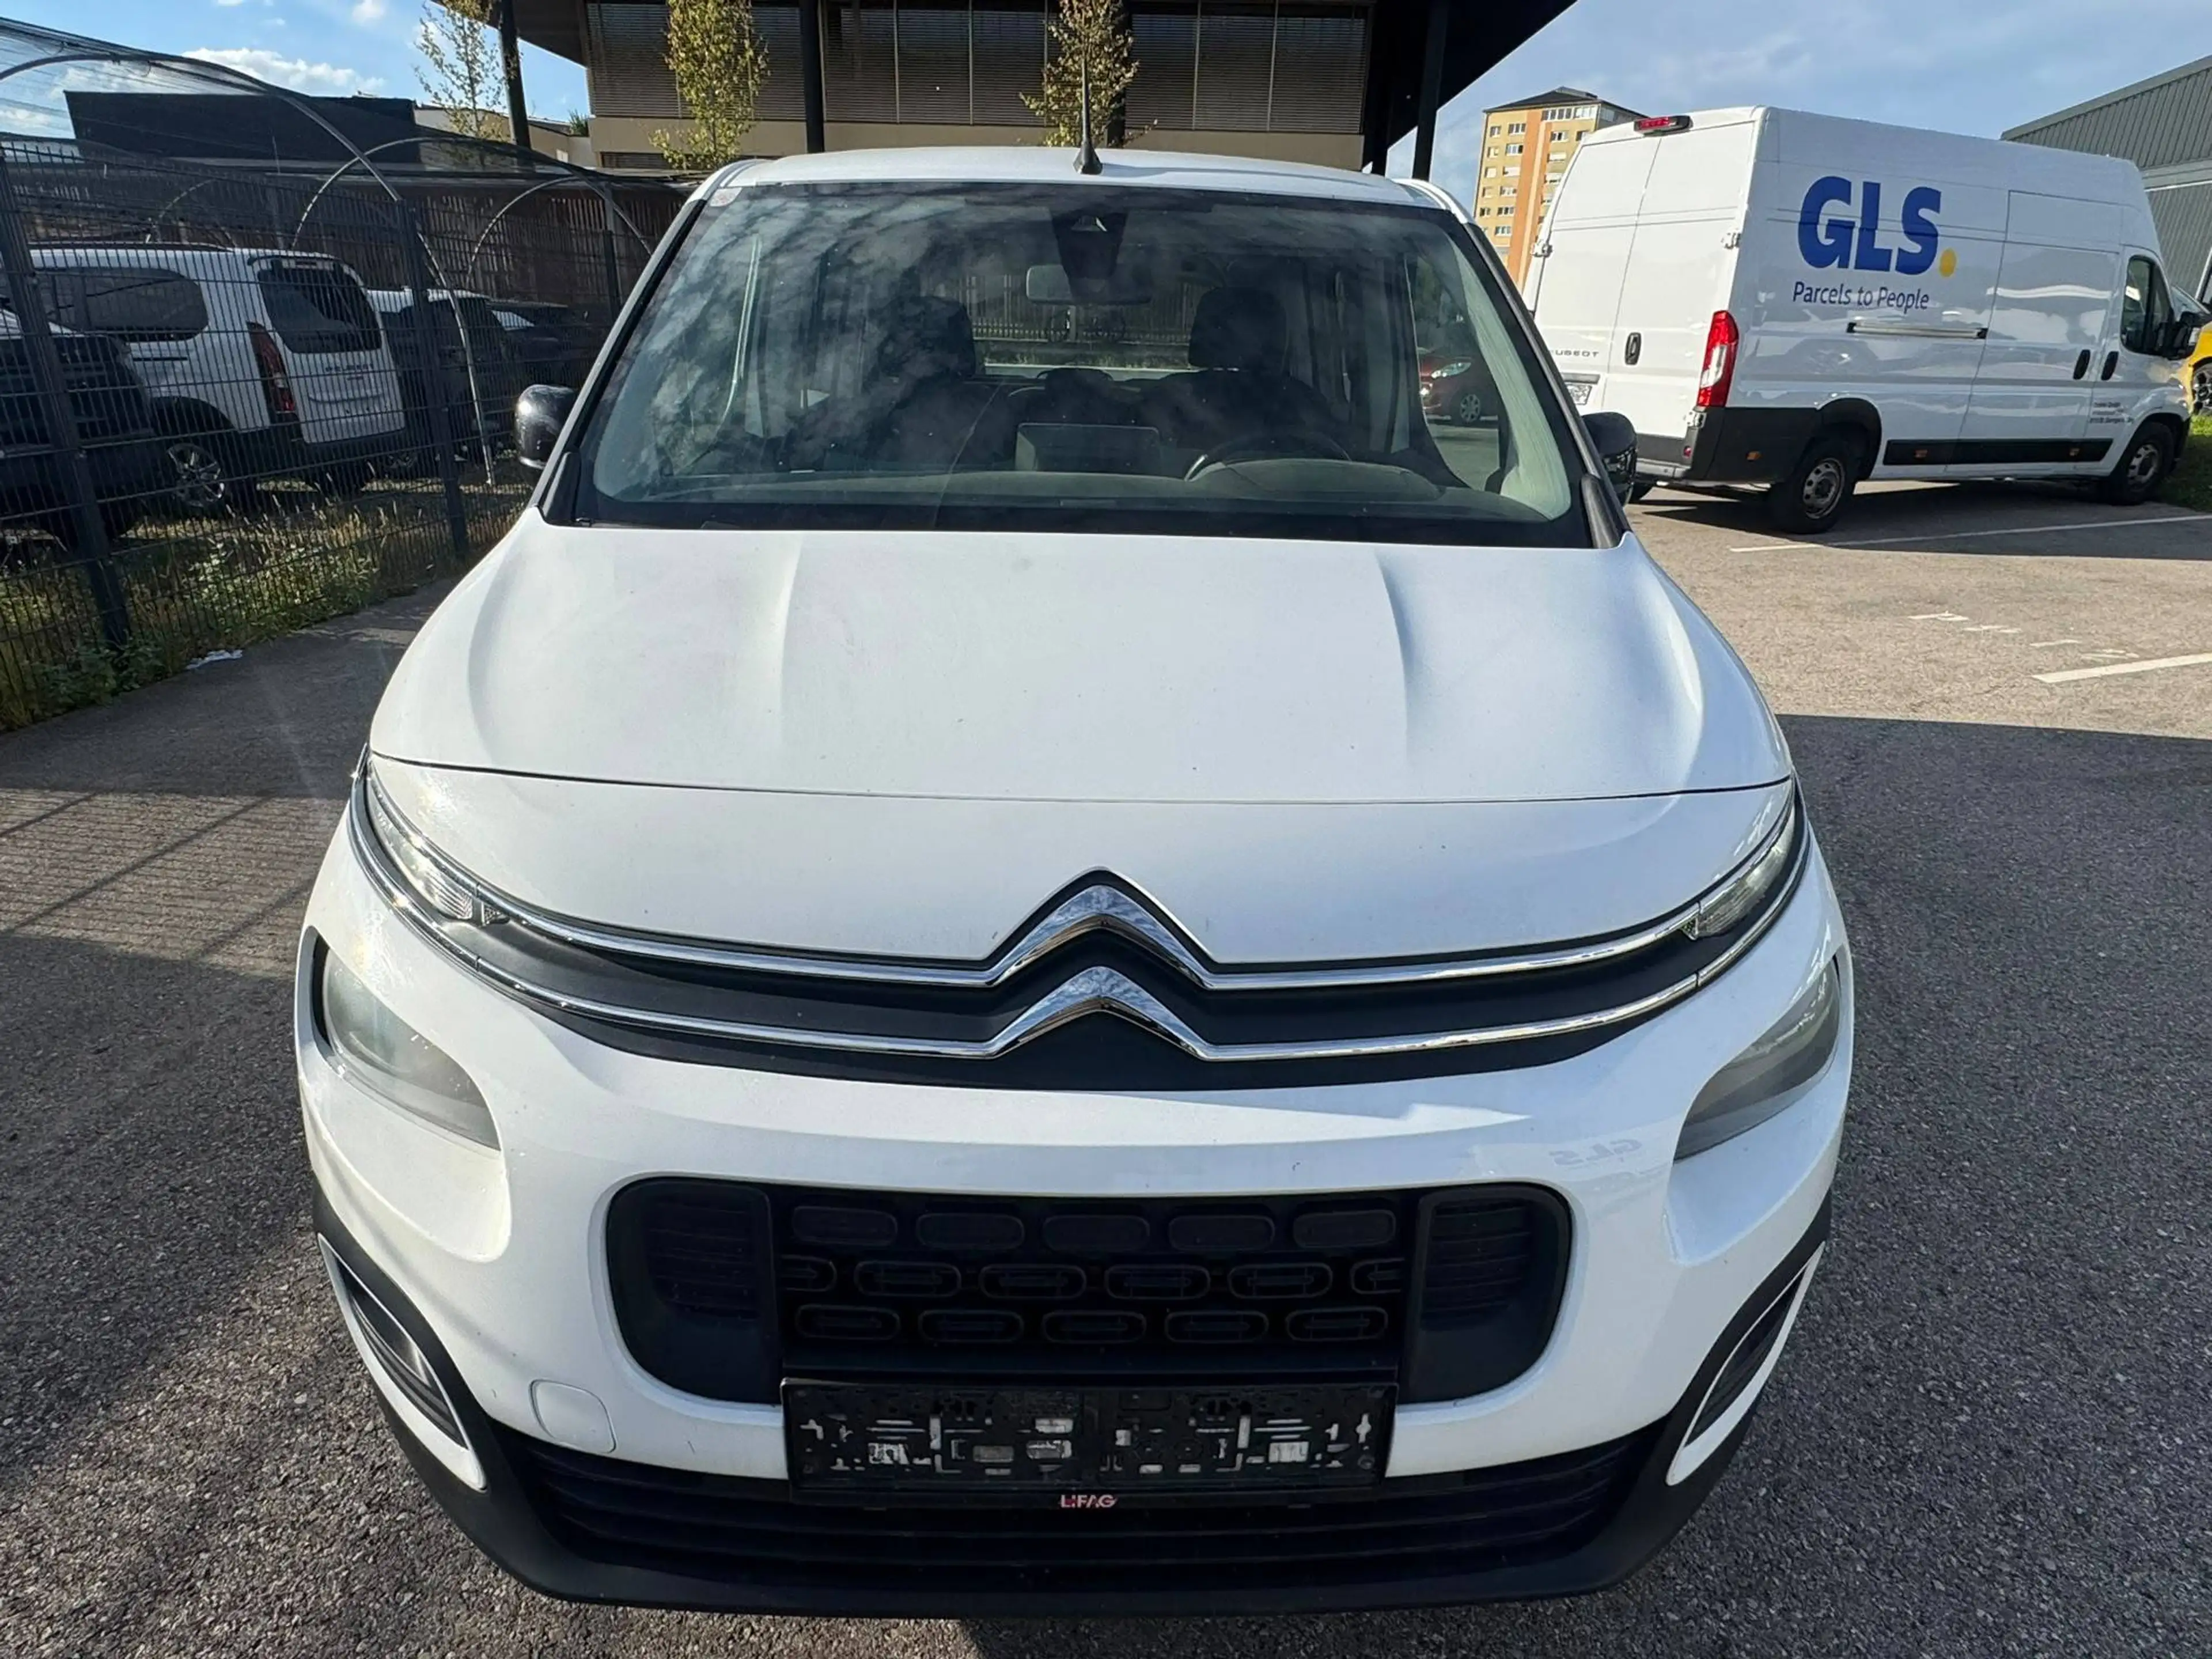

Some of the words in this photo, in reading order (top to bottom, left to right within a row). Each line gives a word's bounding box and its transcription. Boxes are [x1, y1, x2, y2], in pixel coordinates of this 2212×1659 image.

[1793, 281, 1852, 305] Parcels
[1857, 286, 1873, 306] to
[1877, 286, 1930, 315] People
[1550, 349, 1599, 358] UGEOT
[1060, 1494, 1118, 1509] LIFAG
